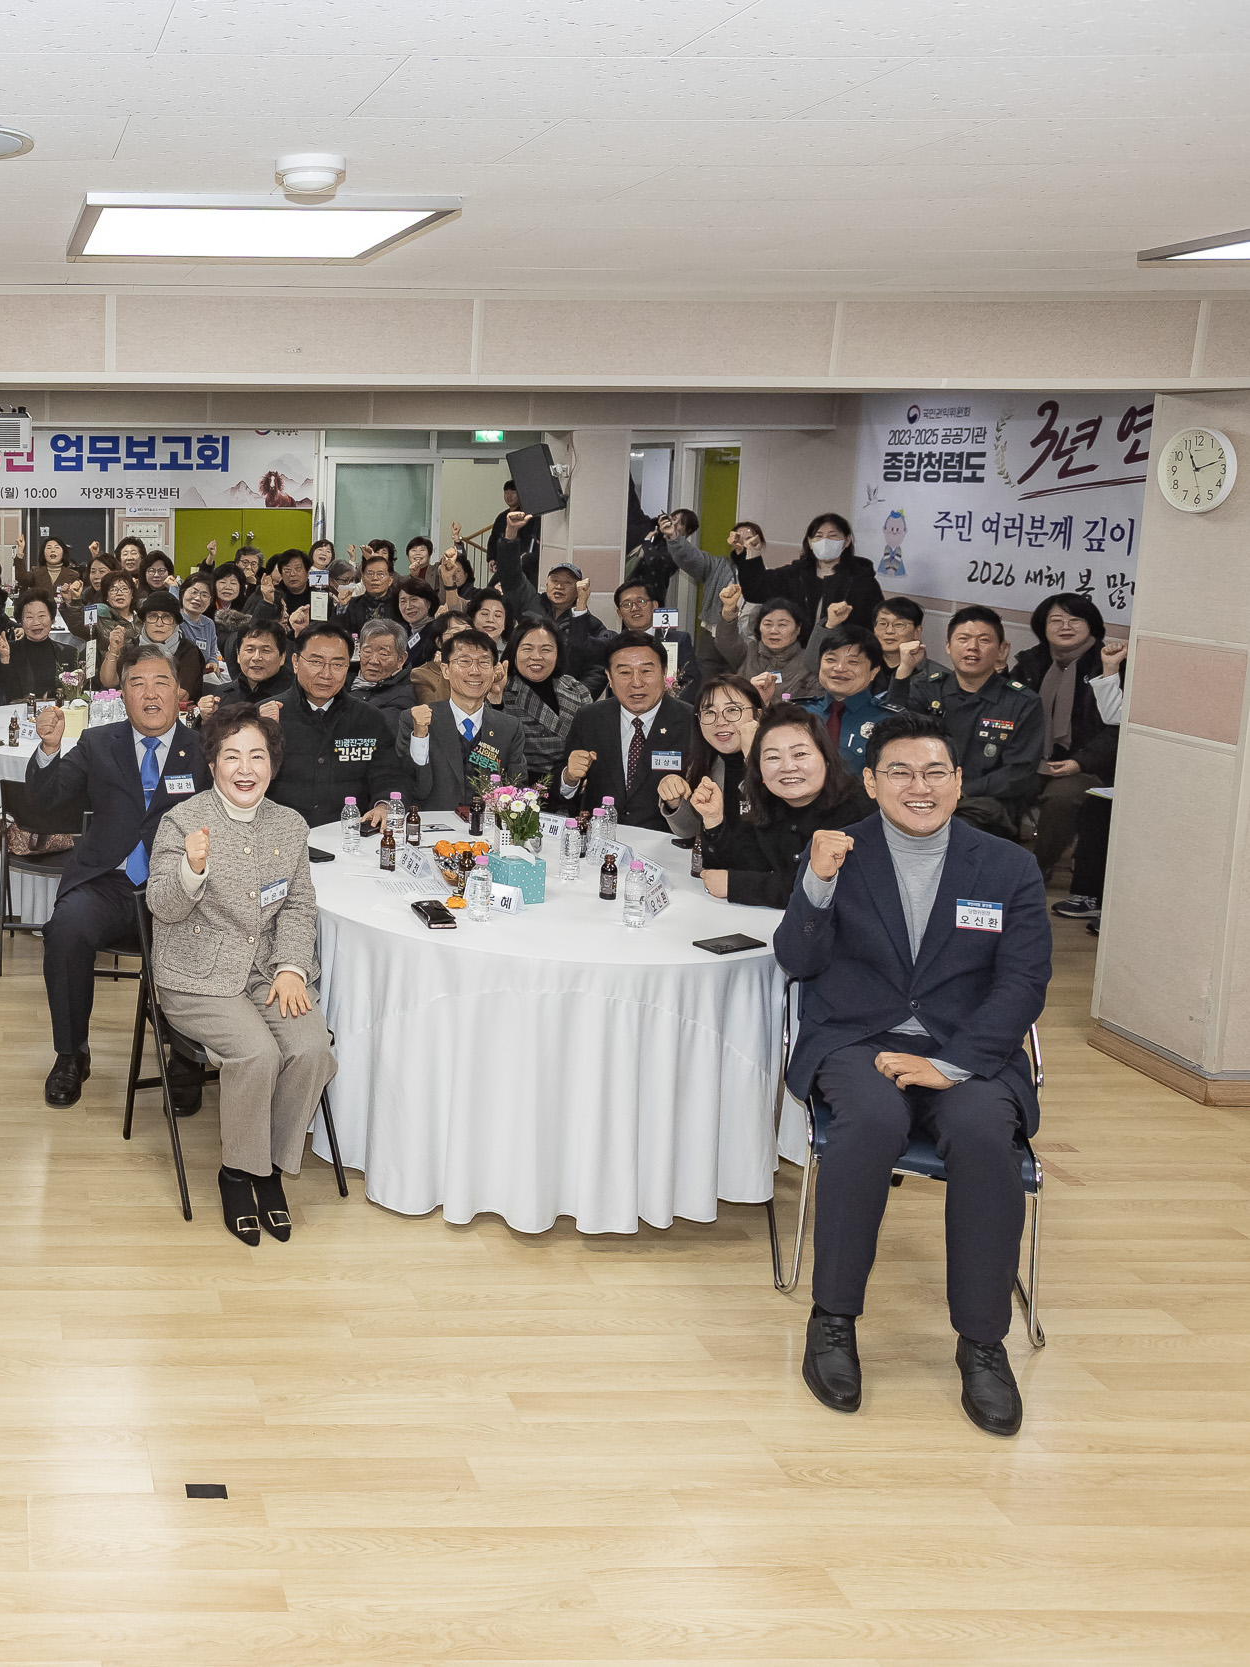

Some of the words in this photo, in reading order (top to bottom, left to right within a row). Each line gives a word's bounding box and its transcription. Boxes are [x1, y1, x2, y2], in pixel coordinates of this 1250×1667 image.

[923, 406, 971, 419] 국민권익위원회
[888, 429, 939, 445] 2023-2025
[941, 427, 987, 444] 공공기관
[1195, 435, 1204, 446] 12
[1017, 400, 1102, 485] 3년
[1185, 439, 1192, 450] 11
[1211, 438, 1214, 448] 1
[49, 434, 230, 472] 업무보고회
[1175, 450, 1183, 461] 10
[1218, 447, 1224, 459] 2
[883, 451, 986, 483] 종합청렴도
[1171, 465, 1177, 476] 9
[1220, 463, 1227, 475] 3
[1172, 479, 1179, 490] 8
[1215, 478, 1222, 488] 4
[23, 487, 57, 499] 10:00
[80, 486, 180, 500] 자양제3동주민센터
[1183, 489, 1189, 500] 7
[1193, 493, 1201, 504] 6
[1207, 489, 1214, 500] 5
[933, 511, 972, 542] 주민
[981, 511, 1073, 551] 여러분께
[1082, 516, 1135, 556] 깊이
[316, 575, 323, 583] 7
[967, 560, 1015, 587] 2026
[1024, 566, 1065, 590] 새해
[662, 613, 669, 624] 3
[338, 747, 373, 761] 김선갑
[469, 750, 499, 772] 전병주
[654, 758, 678, 767] 김상배
[650, 891, 668, 913] 오신환
[959, 915, 999, 929] 오신환
